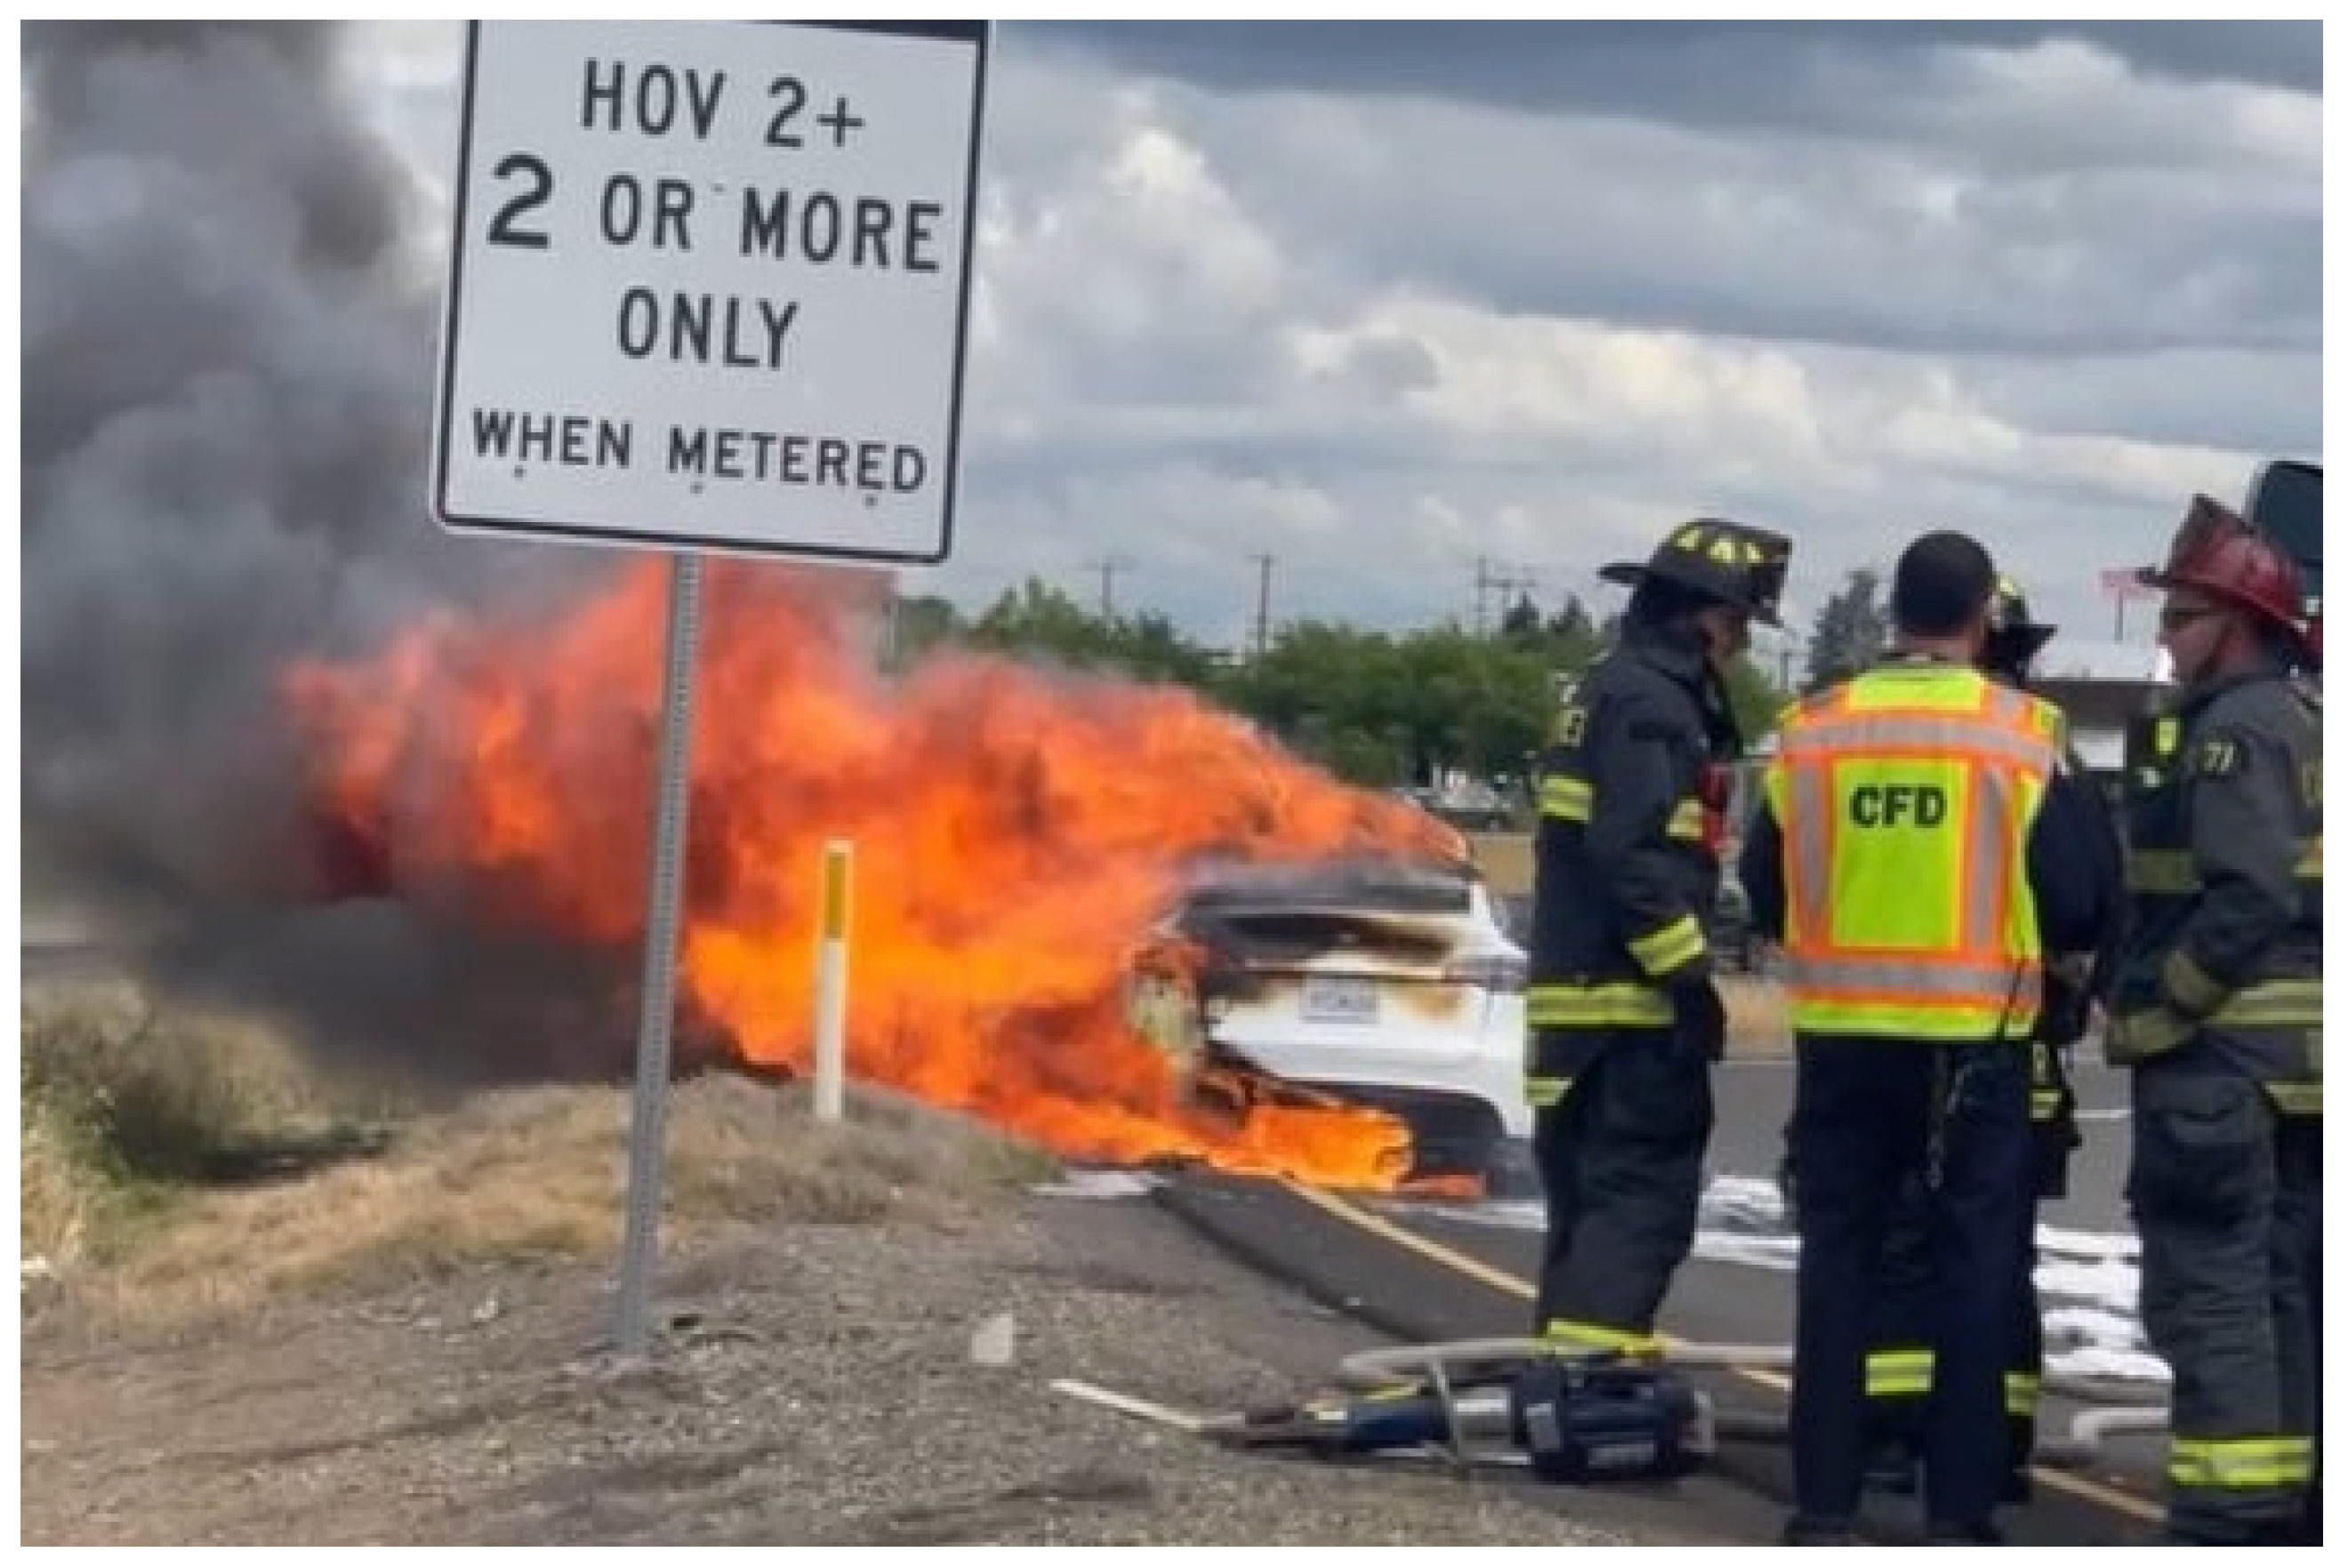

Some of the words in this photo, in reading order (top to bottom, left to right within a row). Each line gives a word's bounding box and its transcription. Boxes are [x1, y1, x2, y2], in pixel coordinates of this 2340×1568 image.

[582, 58, 727, 141] HOV
[764, 76, 866, 149] 2+
[487, 152, 555, 250] 2
[599, 173, 696, 252] OR
[740, 186, 943, 274] MORE
[618, 287, 799, 370] ONLY
[472, 407, 633, 470] WHEN
[666, 427, 928, 495] METERED
[1848, 784, 1948, 830] CFD
